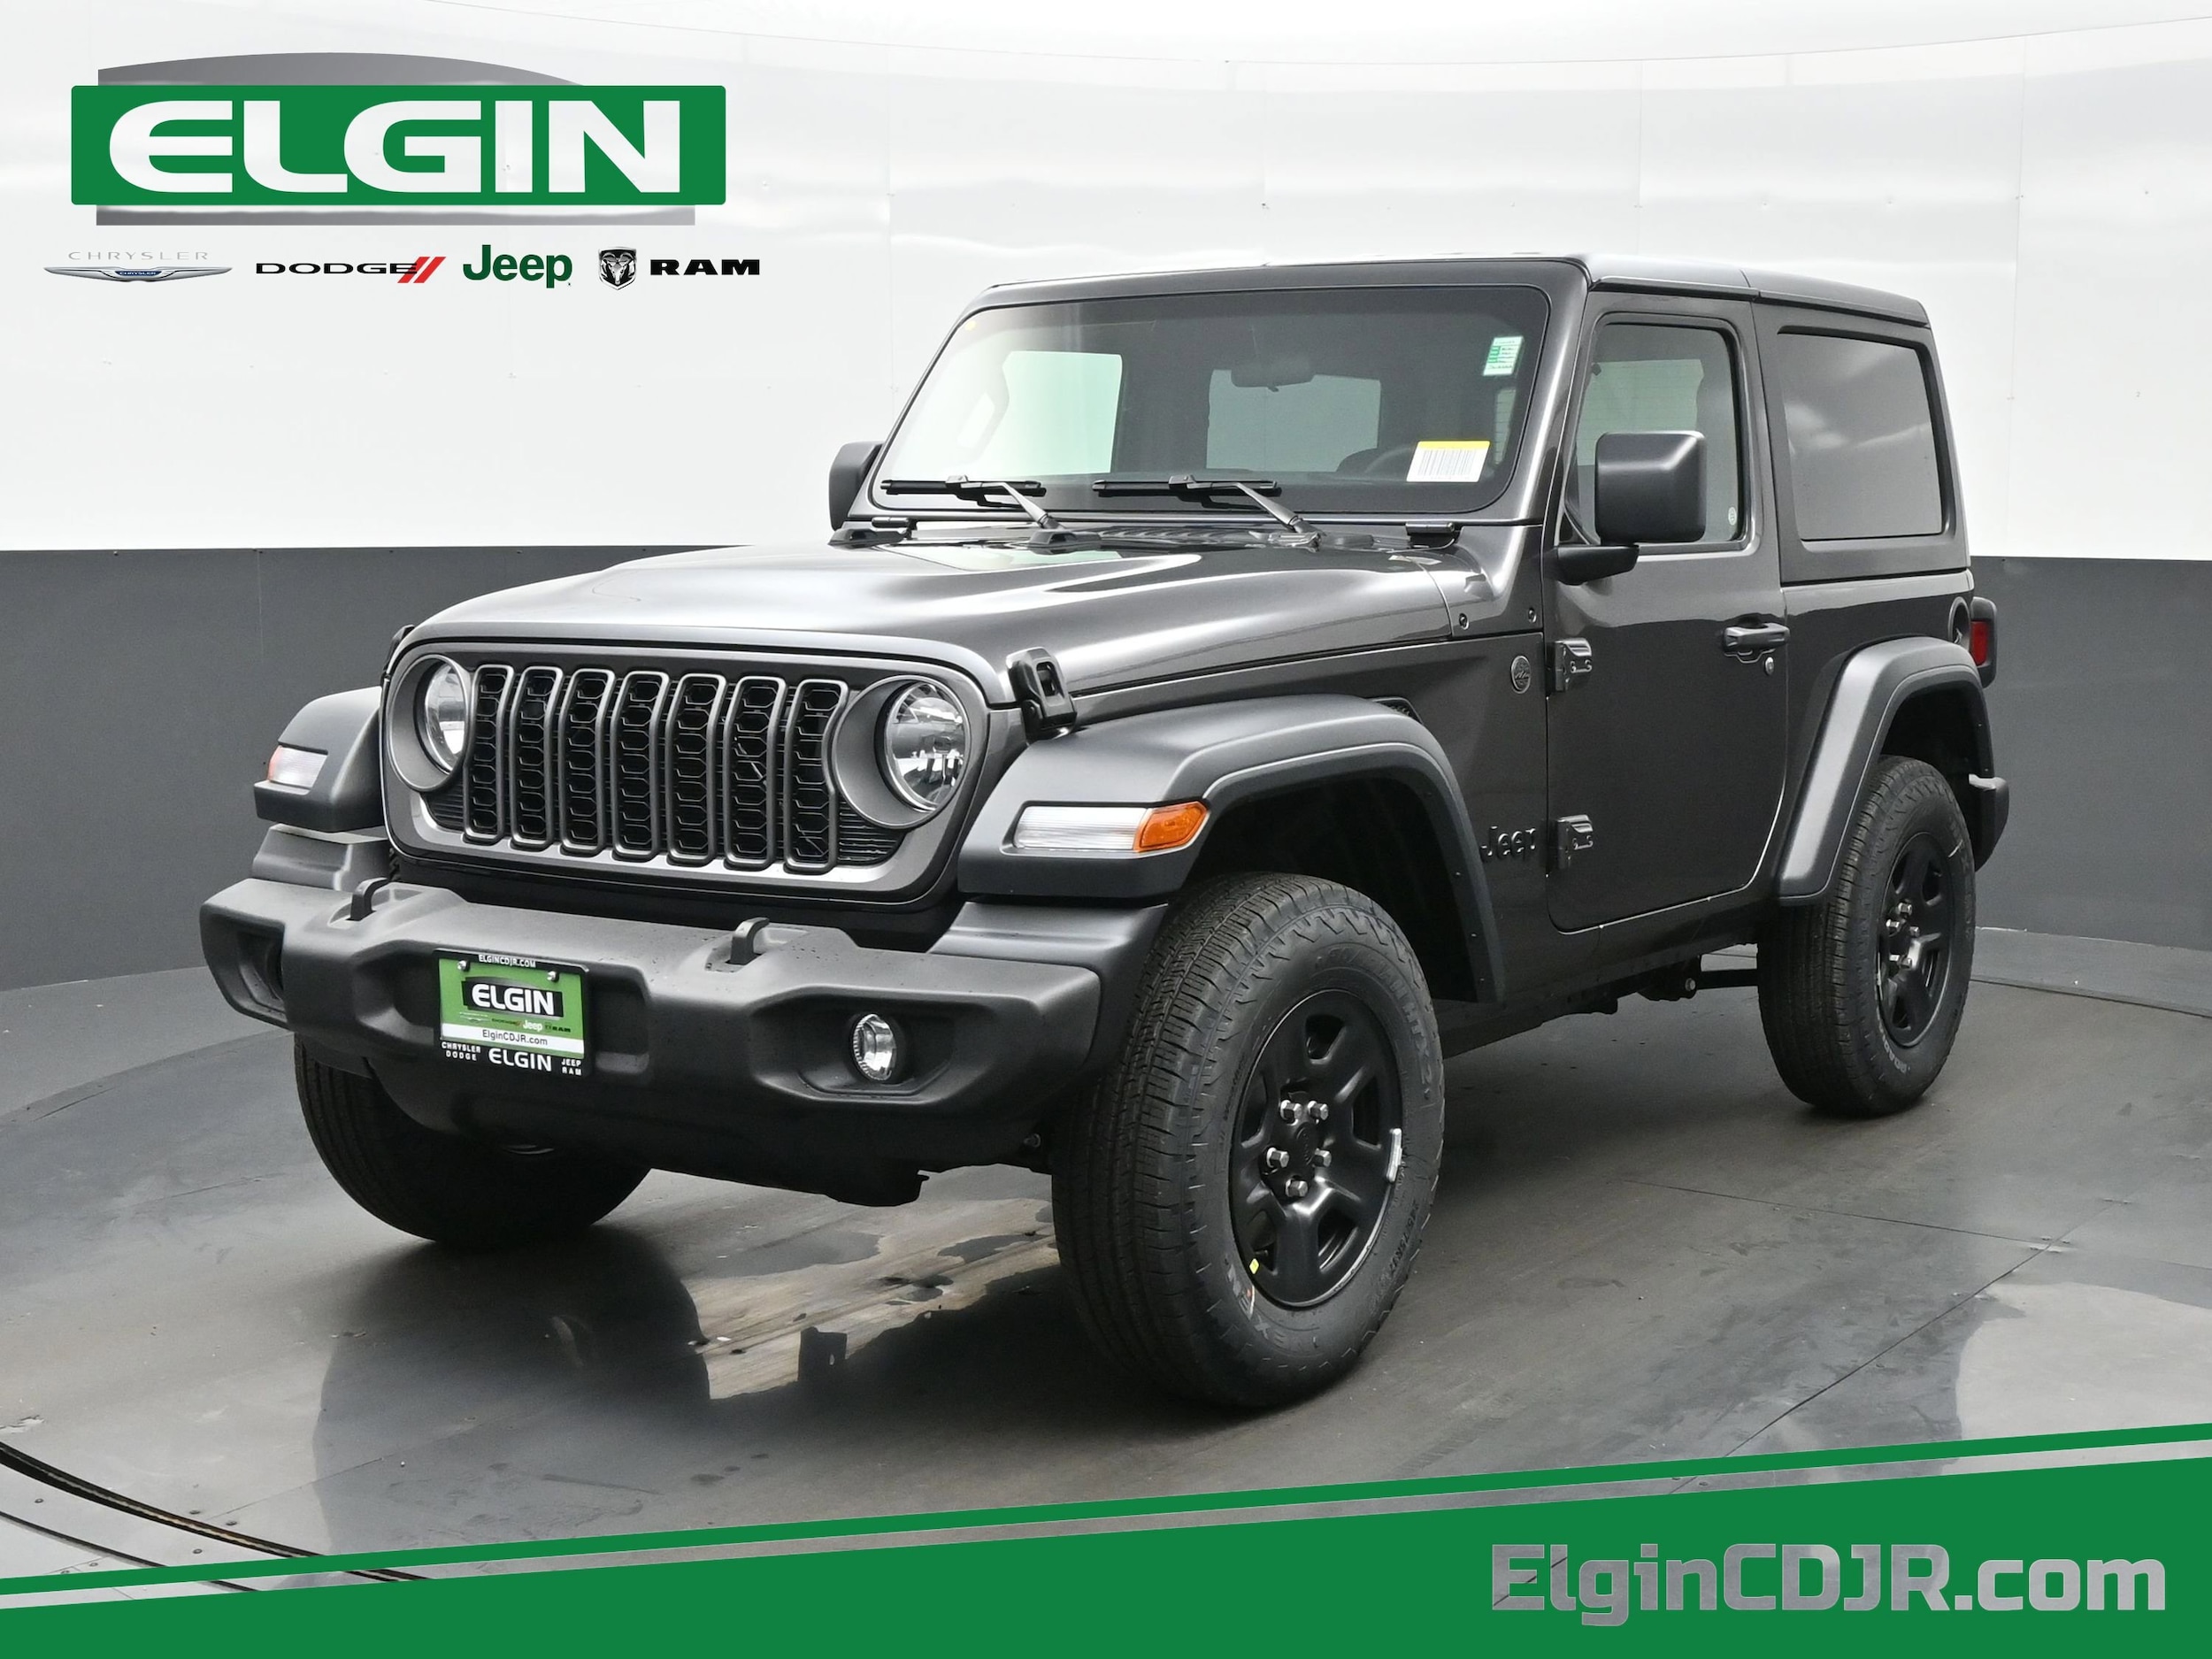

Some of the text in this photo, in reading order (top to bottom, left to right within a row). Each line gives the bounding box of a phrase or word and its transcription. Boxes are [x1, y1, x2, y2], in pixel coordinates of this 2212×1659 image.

[478, 954, 537, 968] ELGINCDJR.COM
[472, 983, 555, 1015] ELGIN
[523, 1019, 542, 1032] Jeep
[482, 1029, 548, 1046] ElginCDJR.com
[442, 1041, 481, 1053] CHRYSLER
[446, 1050, 477, 1061] DODGE
[488, 1048, 552, 1071] ELGIN
[561, 1058, 582, 1067] JEEP
[562, 1066, 582, 1076] RAM
